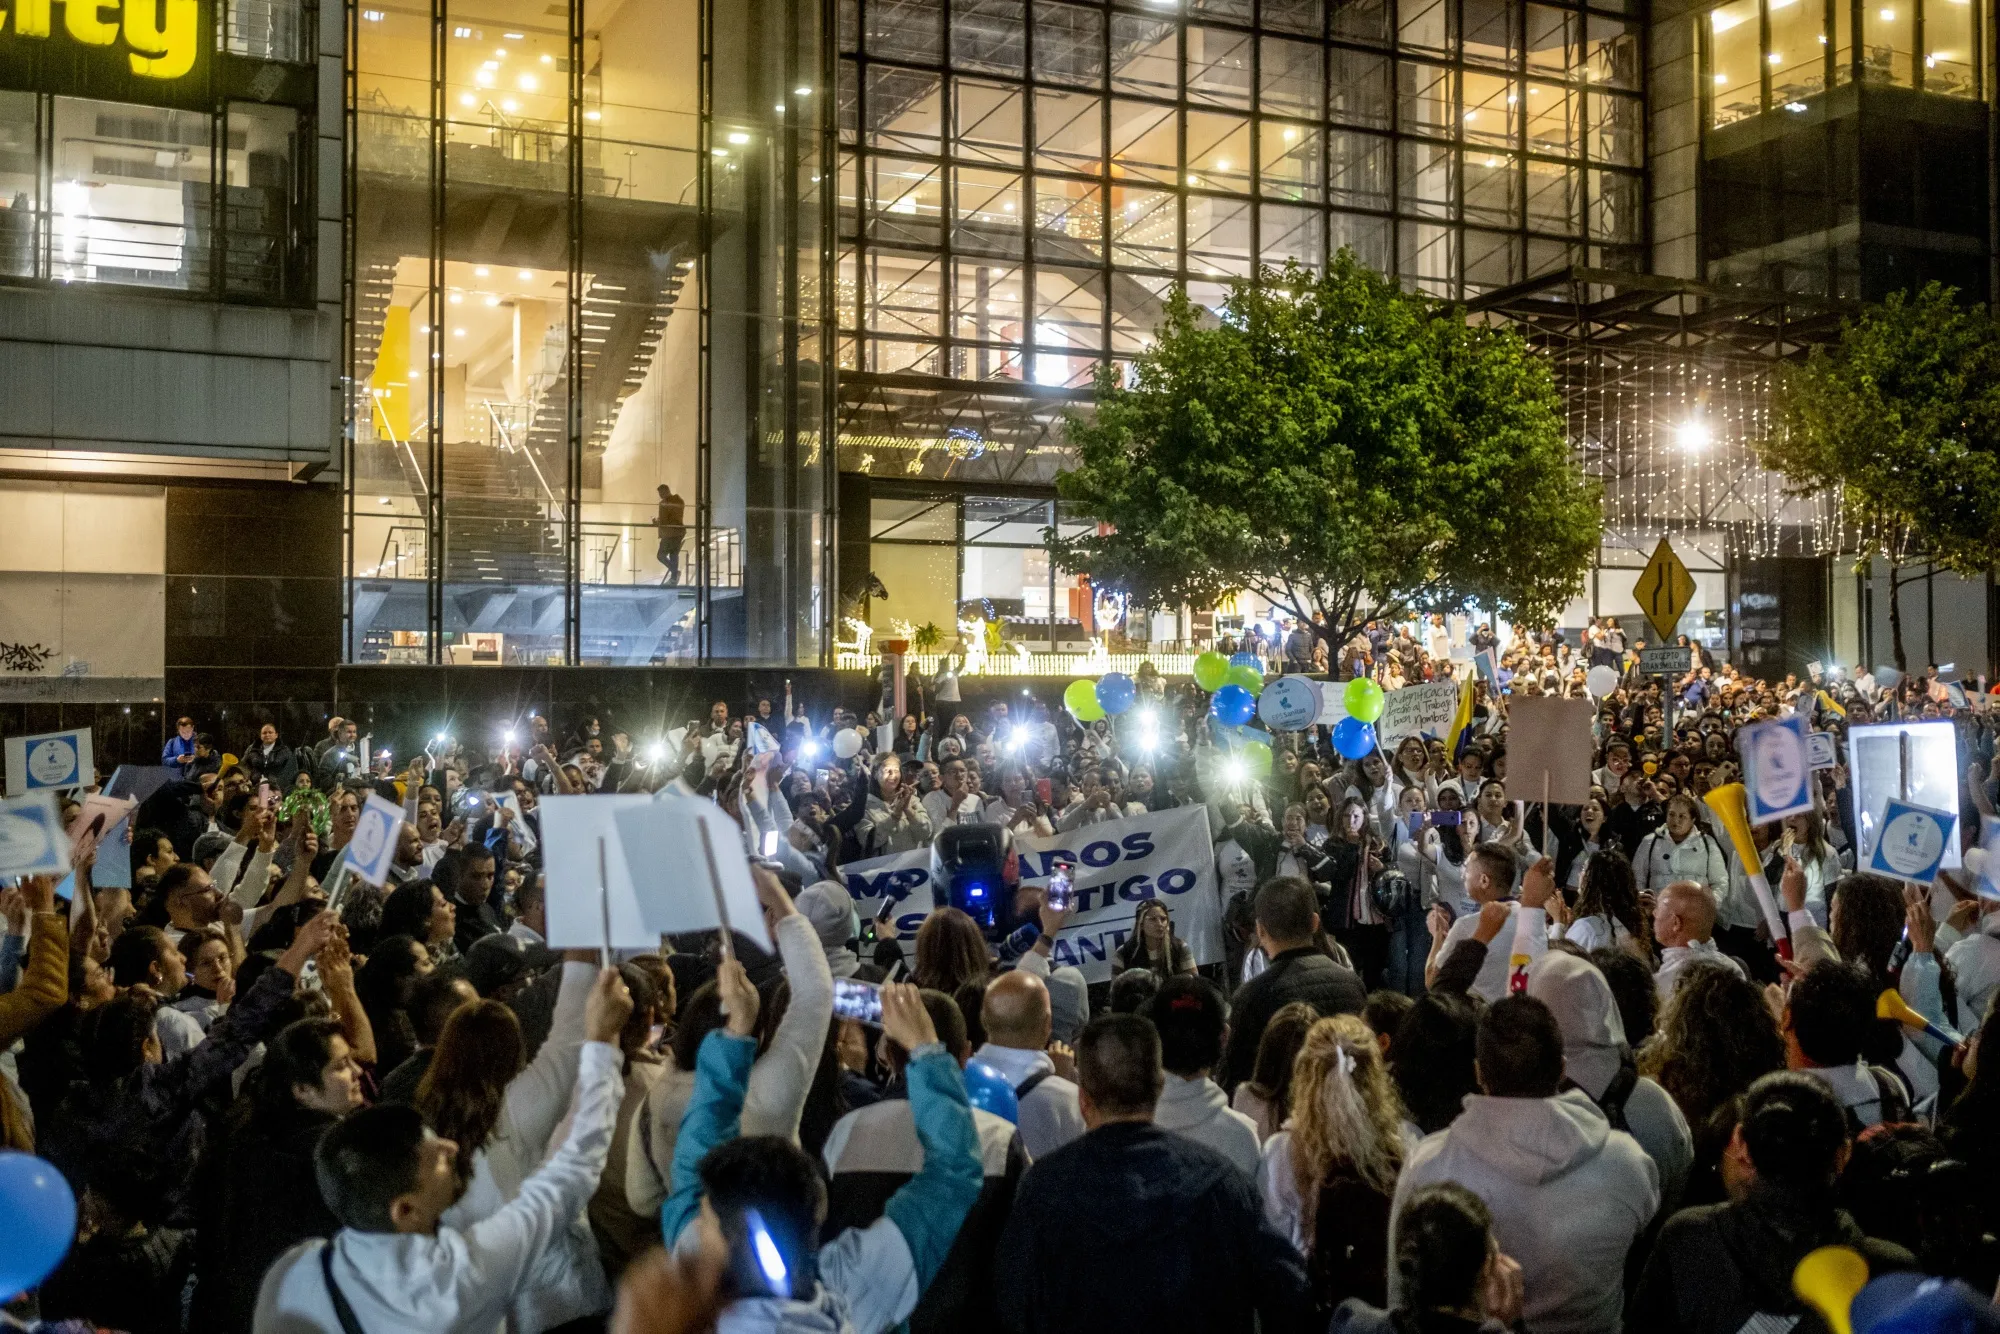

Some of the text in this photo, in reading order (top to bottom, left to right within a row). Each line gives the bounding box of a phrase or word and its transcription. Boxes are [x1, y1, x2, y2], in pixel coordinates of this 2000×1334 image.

[1650, 651, 1680, 660] EXCEPTO
[1641, 661, 1690, 671] TRANSMILENIO
[1284, 707, 1306, 718] Sanitas
